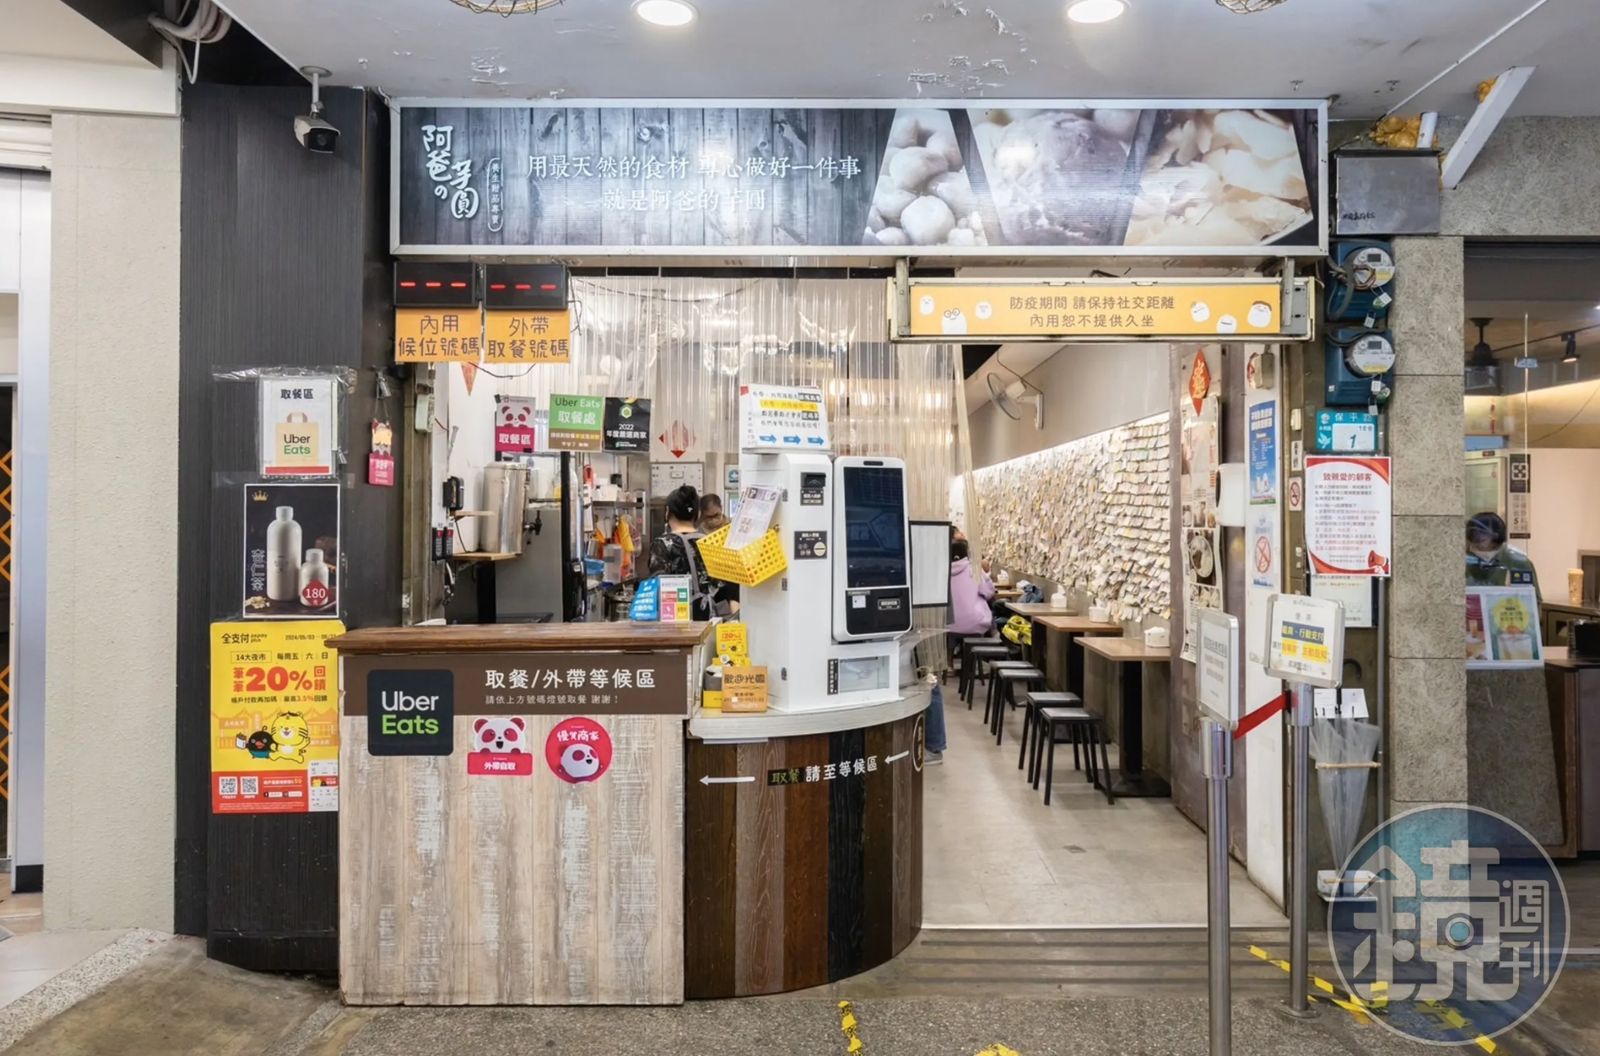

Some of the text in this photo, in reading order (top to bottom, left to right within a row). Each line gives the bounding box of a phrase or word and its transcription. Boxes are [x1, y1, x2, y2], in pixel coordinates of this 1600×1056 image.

[527, 155, 689, 180] 用最天然的食材
[1009, 296, 1175, 310] 防疫期間 請保持社交距離
[420, 314, 459, 335] 內用
[508, 316, 549, 337] 外帶
[1029, 313, 1156, 328] 內用恕不提供久坐
[398, 337, 480, 357] 候位號碼
[488, 339, 569, 359] 取餐號碼
[280, 388, 314, 400] 取餐區
[554, 397, 578, 407] Uber
[283, 433, 311, 444] Uber
[283, 444, 311, 455] Eats
[305, 588, 326, 599] 180
[245, 666, 313, 692] 20%
[485, 669, 656, 690] 取餐/外帶等候區
[381, 691, 439, 712] Uber
[381, 715, 439, 735] Eats
[805, 755, 878, 782] 請至等候區
